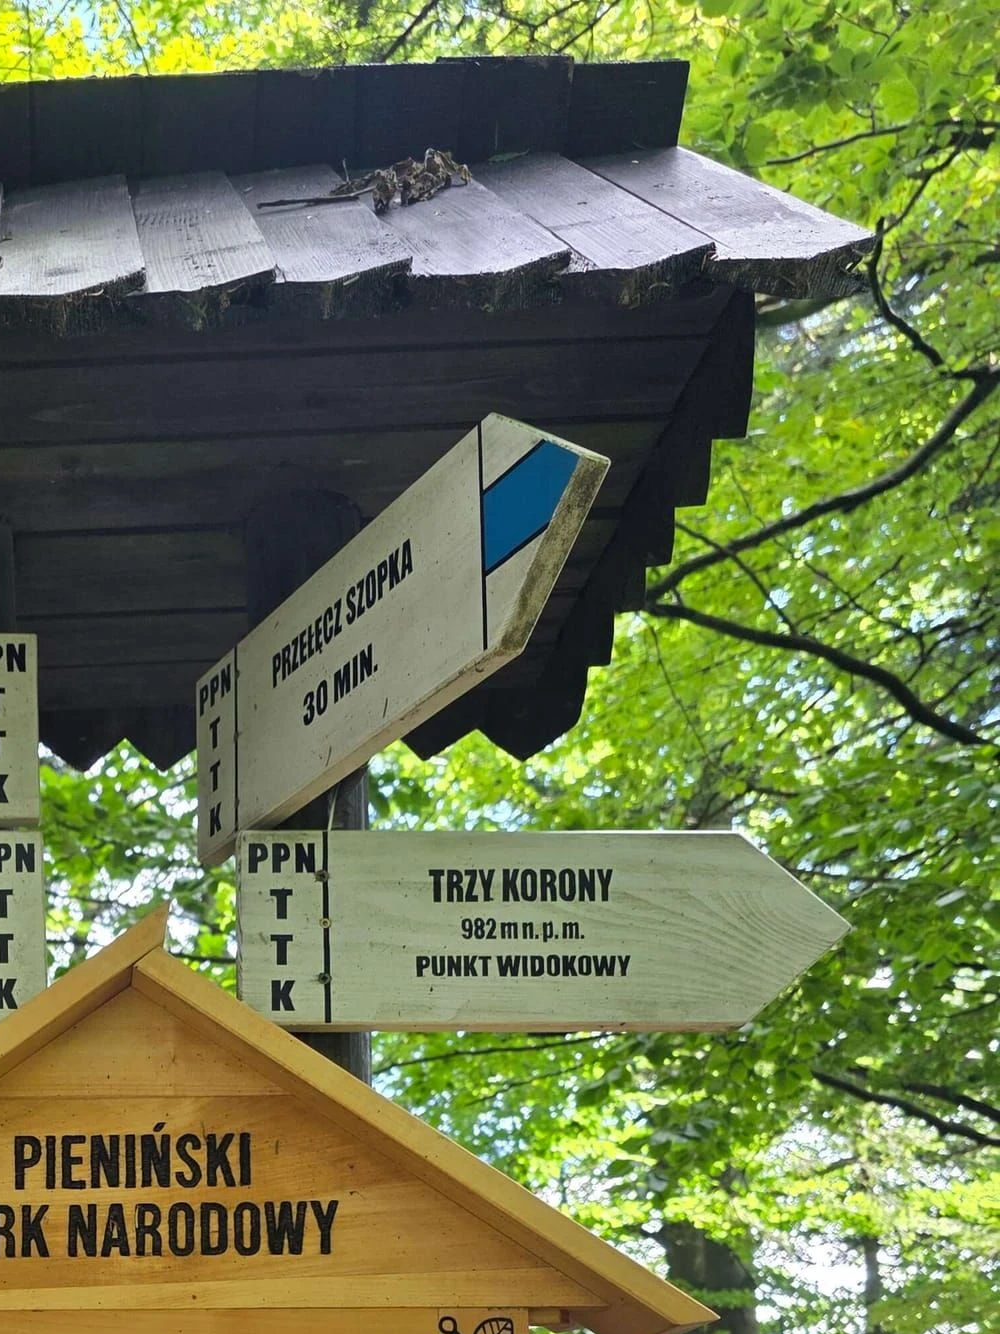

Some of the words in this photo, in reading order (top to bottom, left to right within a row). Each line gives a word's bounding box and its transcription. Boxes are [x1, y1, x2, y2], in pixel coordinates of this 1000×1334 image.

[272, 598, 342, 688] PRZEŁĘCZ
[346, 538, 413, 625] SZOPKA
[200, 664, 231, 717] PPN
[303, 680, 327, 726] 30
[334, 644, 378, 704] MIN.
[248, 843, 316, 873] PPN
[429, 869, 495, 902] TRZY
[503, 868, 612, 902] KORONY
[416, 956, 491, 977] PUNKT
[497, 955, 630, 976] WIDOKOWY
[14, 1122, 251, 1190] PIENIŃSKI
[68, 1200, 338, 1257] NARODOWY
